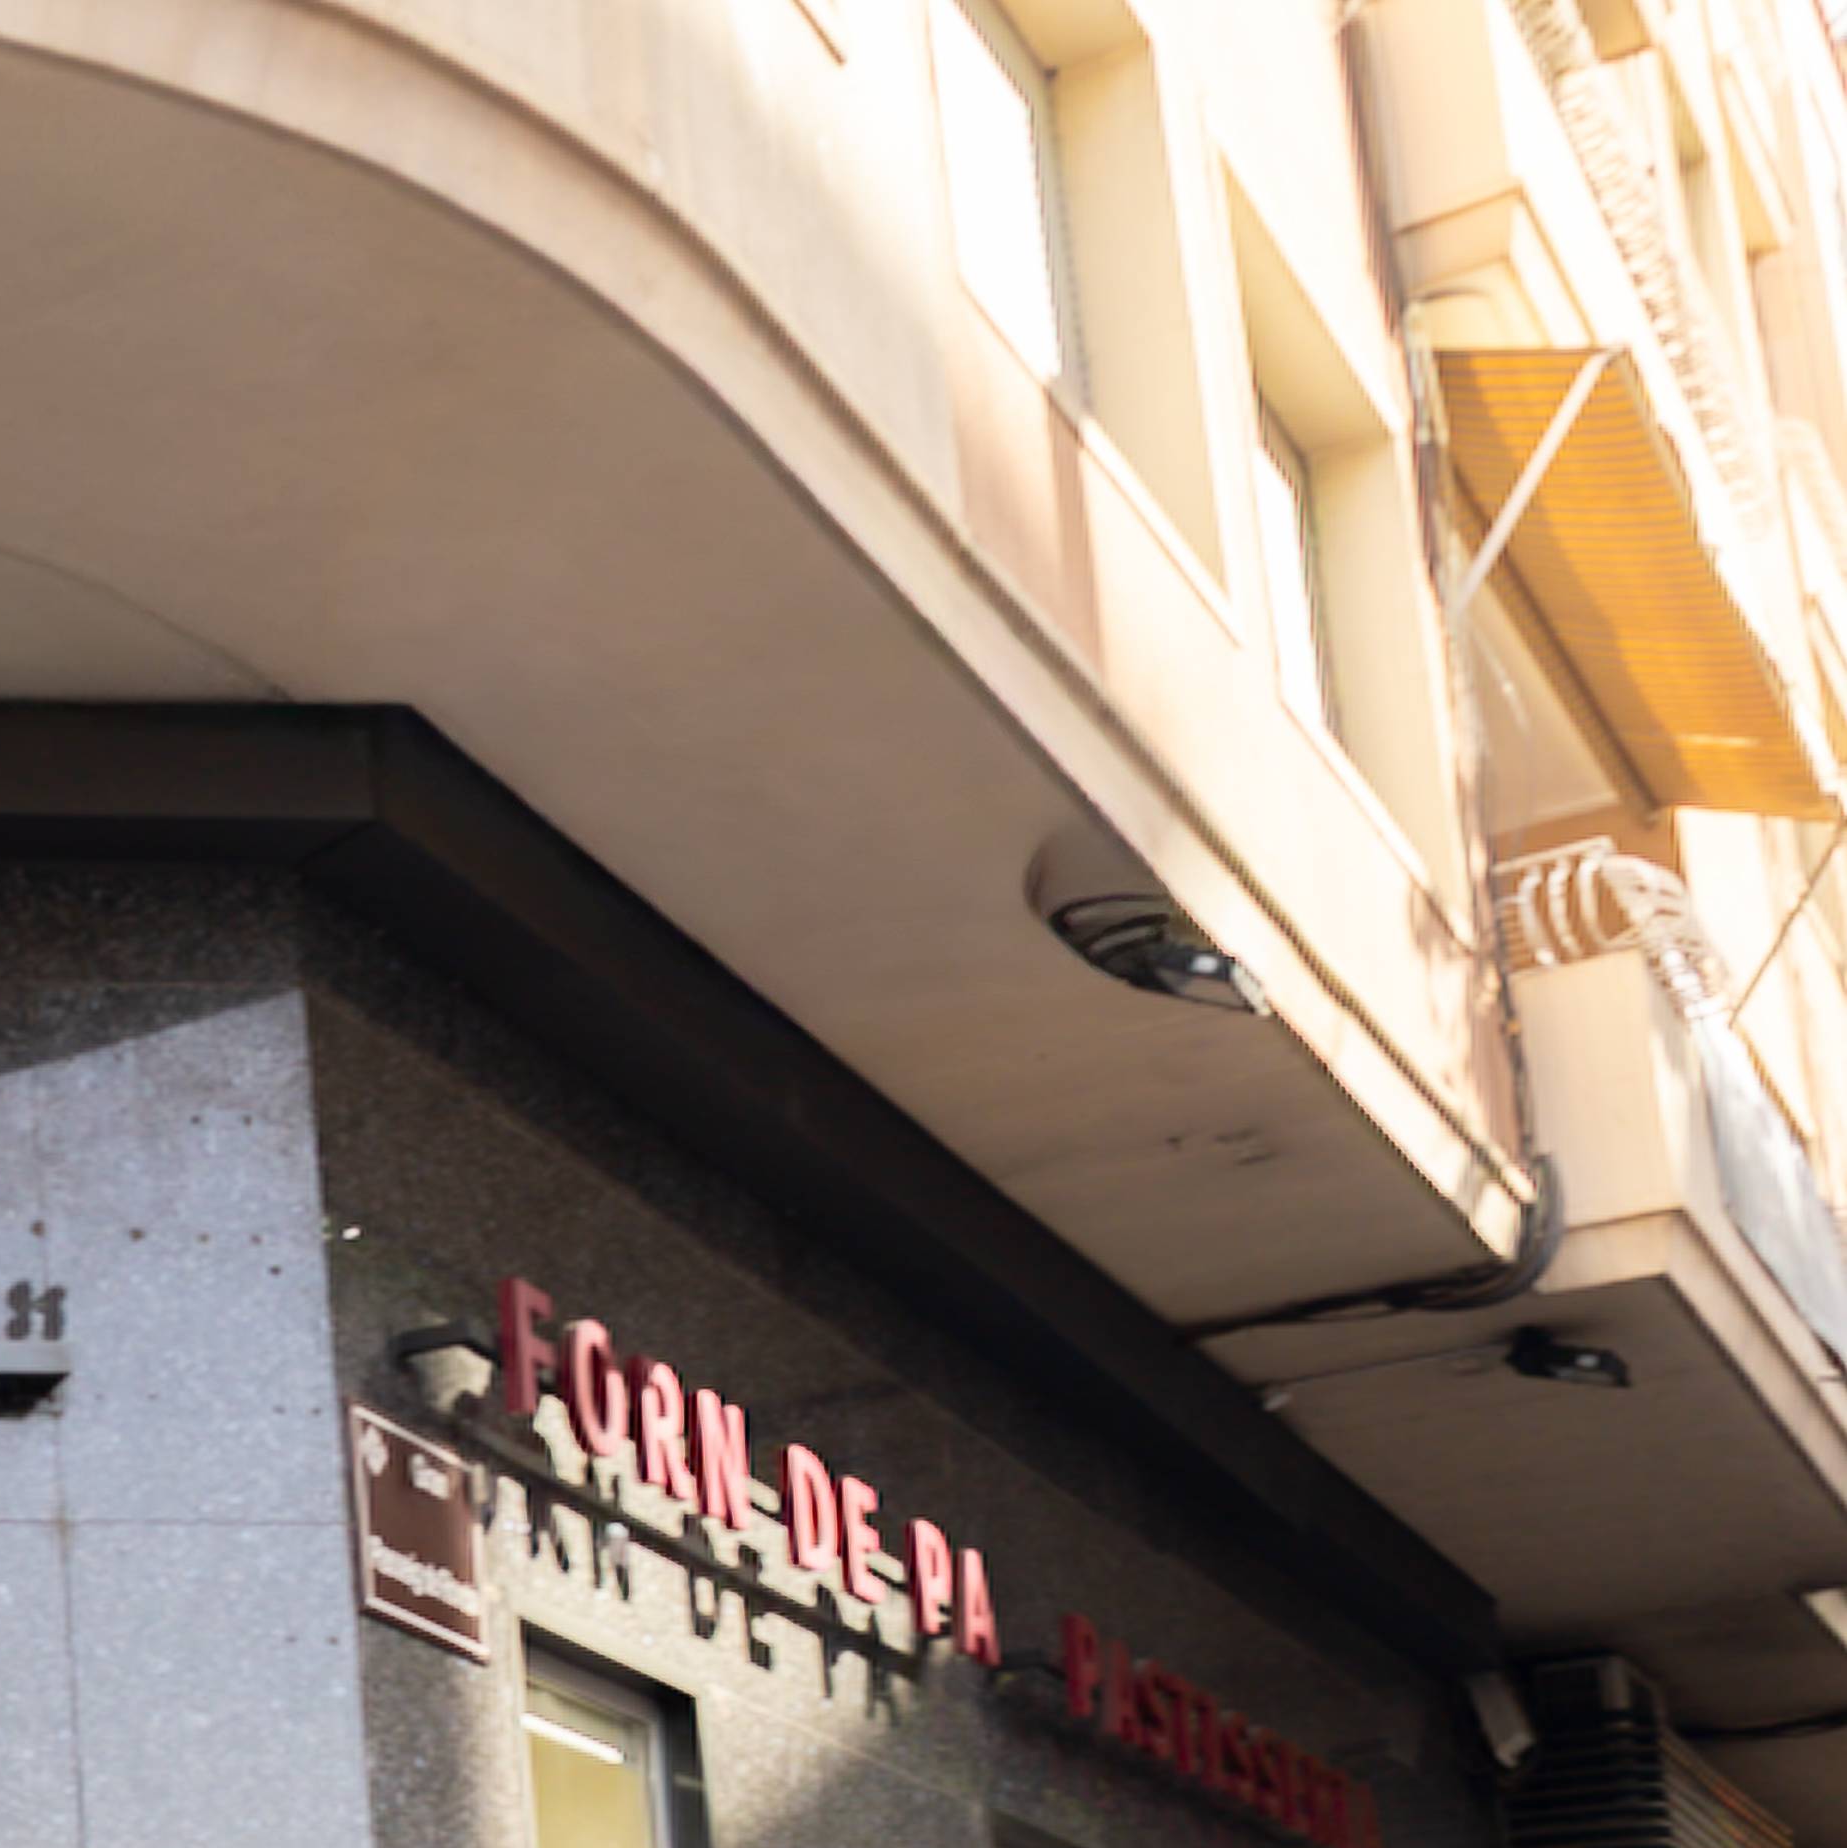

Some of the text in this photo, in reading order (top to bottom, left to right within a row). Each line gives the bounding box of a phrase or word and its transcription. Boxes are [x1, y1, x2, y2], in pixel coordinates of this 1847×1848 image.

[497, 1276, 751, 1531] FORN
[780, 1442, 887, 1604] DE
[906, 1516, 1001, 1667] PA
